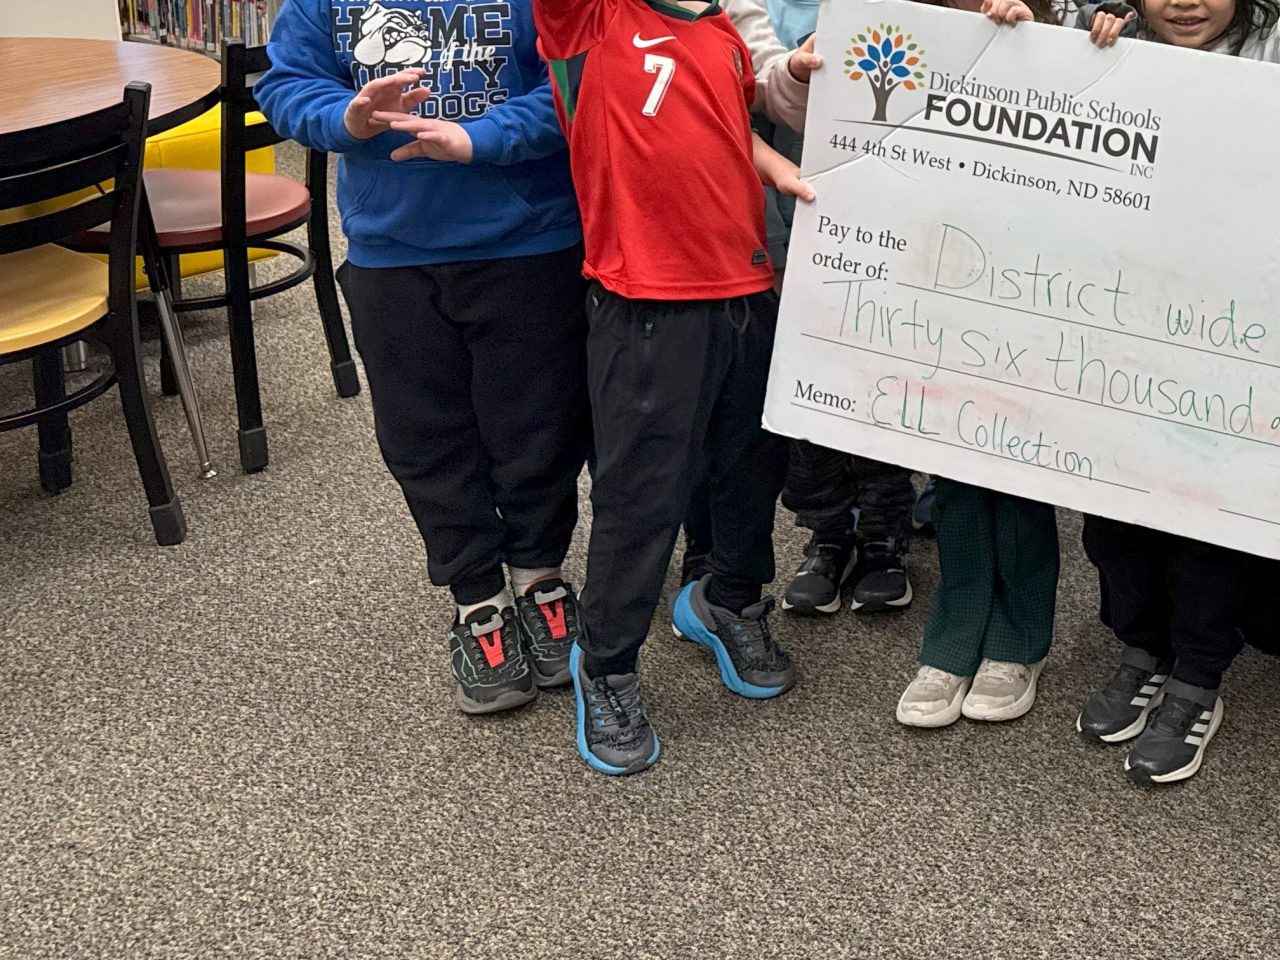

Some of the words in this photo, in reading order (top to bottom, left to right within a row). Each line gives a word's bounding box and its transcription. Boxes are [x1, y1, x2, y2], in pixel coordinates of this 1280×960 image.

[440, 41, 460, 70] of
[461, 40, 496, 62] the
[642, 53, 675, 117] 7
[924, 94, 1159, 164] FOUNDATION
[929, 71, 1020, 106] Dickinson
[1025, 87, 1083, 117] Public
[1087, 98, 1161, 131] Schools
[829, 133, 857, 152] 444
[862, 138, 887, 158] 4th
[891, 144, 908, 162] St
[912, 148, 952, 172] West
[972, 160, 1062, 196] Dickinson,
[1066, 180, 1098, 200] ND
[1102, 187, 1152, 212] 58601
[1129, 162, 1154, 179] INC
[816, 216, 852, 244] Pay
[856, 228, 874, 246] to
[878, 230, 907, 252] the
[811, 251, 862, 276] order
[865, 261, 888, 282] of:
[933, 223, 1131, 326] District
[1166, 300, 1266, 354] wide
[822, 278, 944, 380] Thirty
[960, 328, 1028, 378] six
[1046, 331, 1254, 436] thousand
[793, 379, 857, 413] Memo:
[870, 375, 940, 436] ELL
[957, 400, 1094, 481] Collection
